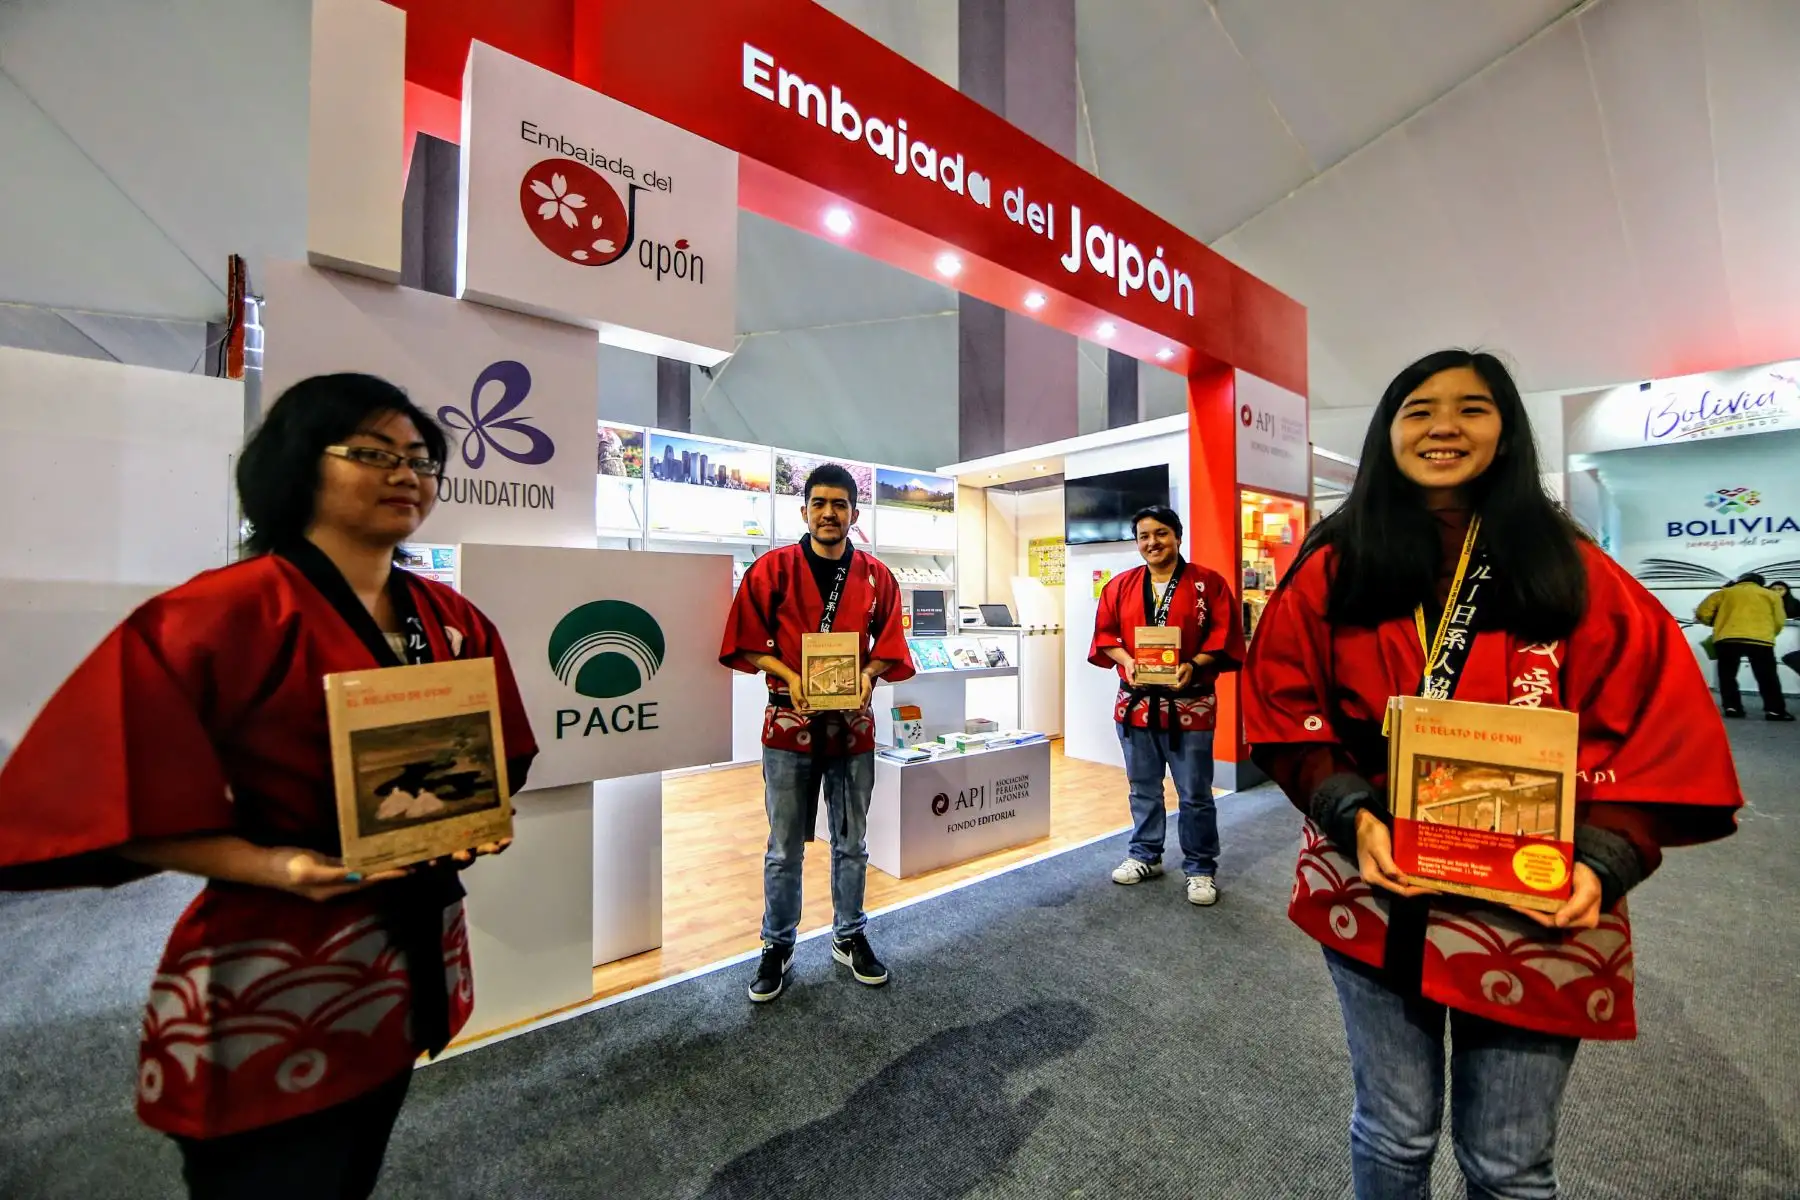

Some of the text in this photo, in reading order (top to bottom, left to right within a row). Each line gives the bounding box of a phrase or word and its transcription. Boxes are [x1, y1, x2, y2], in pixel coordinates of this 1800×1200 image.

[521, 120, 672, 193] Embajada del
[743, 42, 1194, 317] Embajada del Japón
[1255, 408, 1275, 439] APJ
[1644, 390, 1776, 441] Bolivia
[437, 476, 555, 510] OUNDATION
[1667, 516, 1800, 537] BOLIVIA
[556, 702, 660, 740] PACE
[955, 785, 985, 811] APJ
[995, 782, 1029, 795] PERUANO
[995, 790, 1029, 805] JAPONESA
[947, 809, 1016, 833] FONDO EDITORIAL
